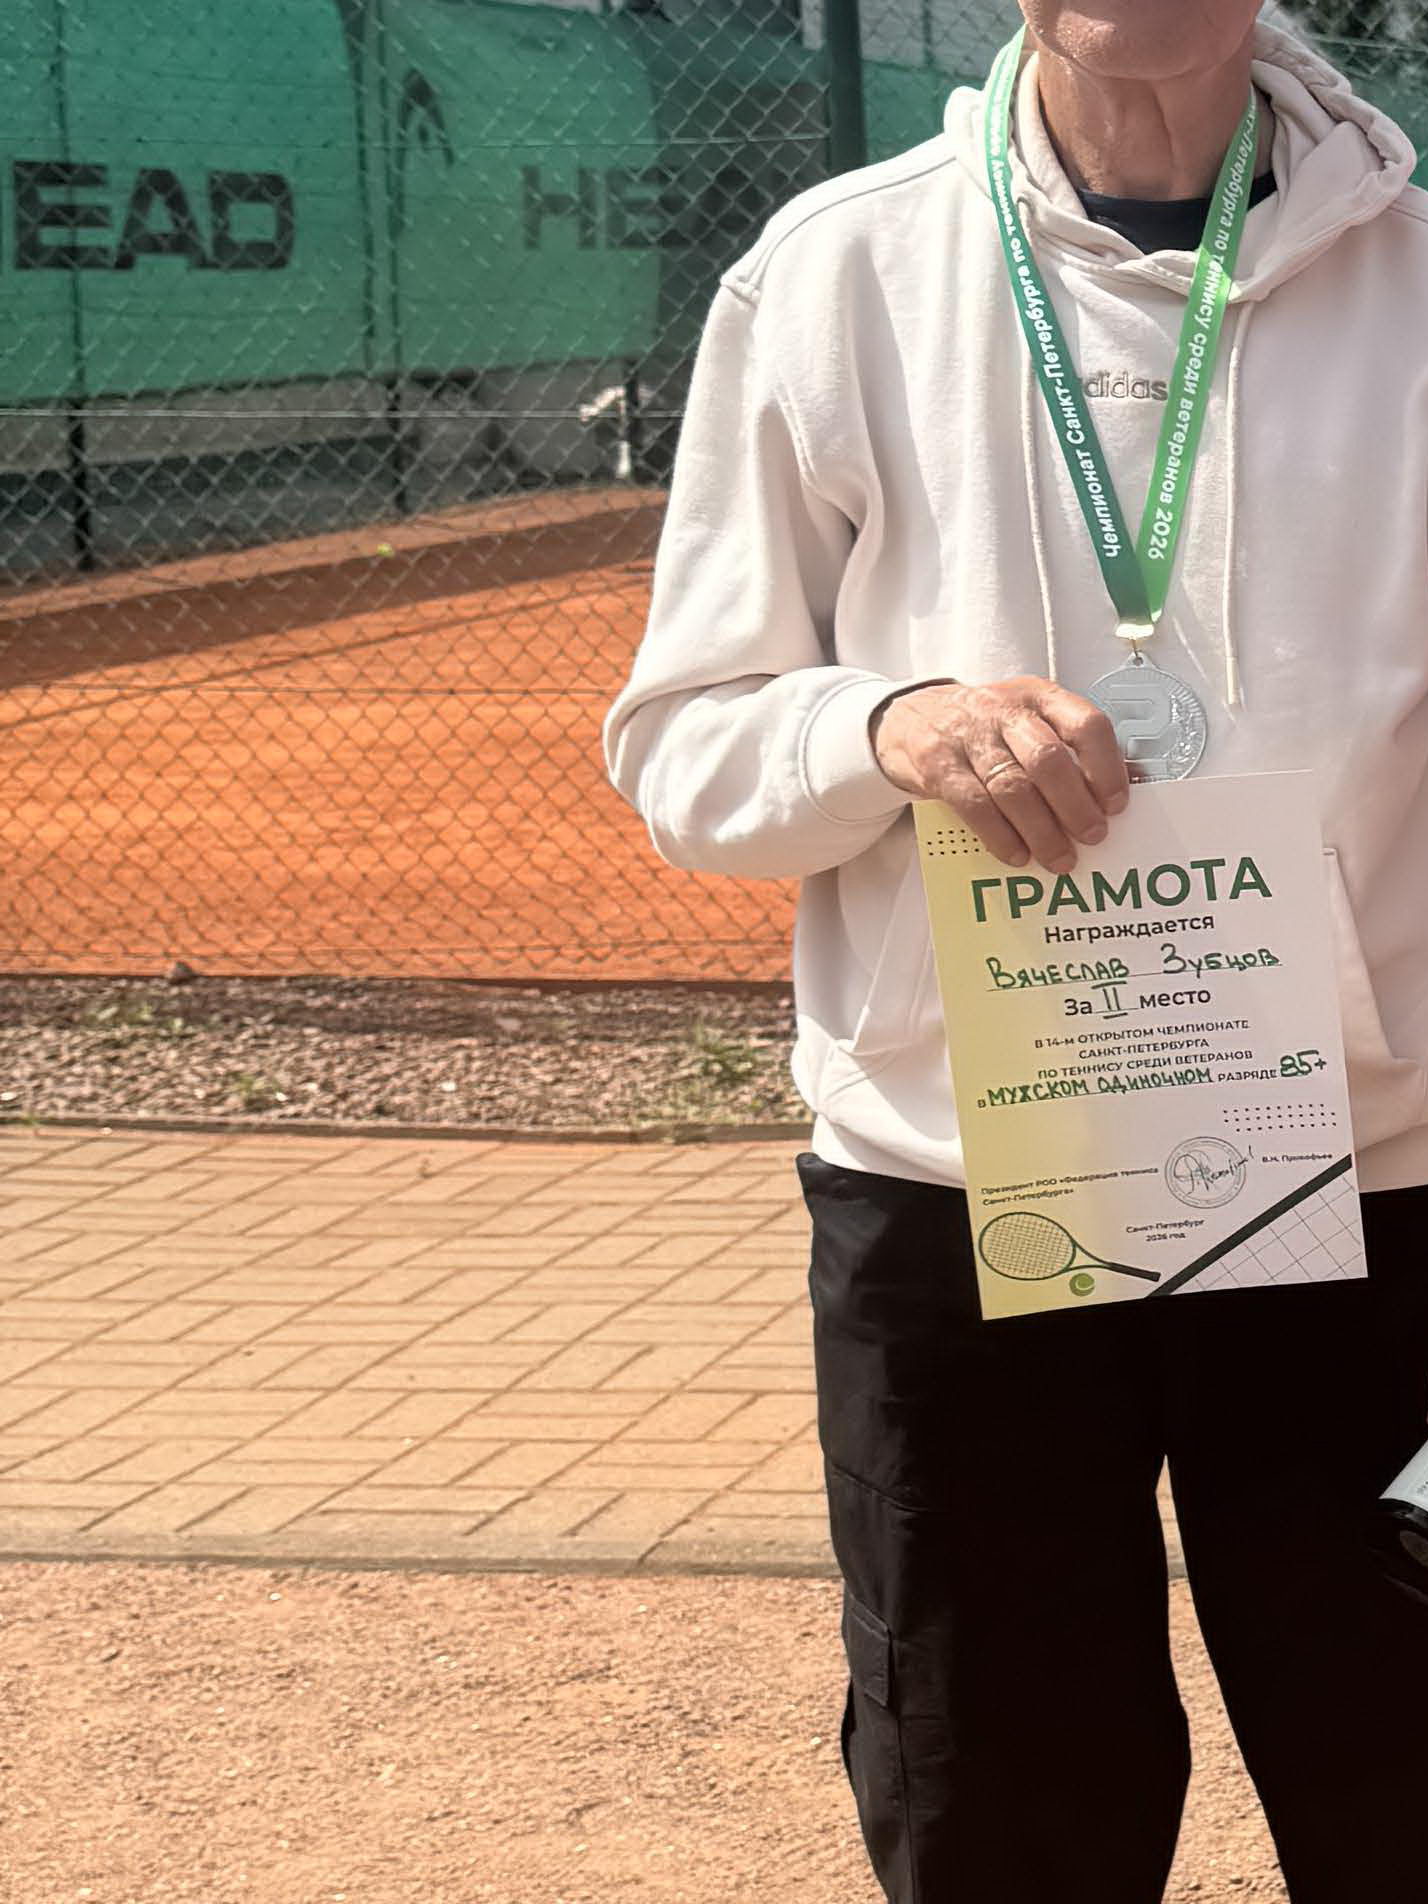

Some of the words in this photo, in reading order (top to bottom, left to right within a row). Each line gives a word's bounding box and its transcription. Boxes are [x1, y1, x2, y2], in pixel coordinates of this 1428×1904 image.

[1010, 238, 1026, 264] по
[1214, 229, 1230, 251] по
[1194, 255, 1225, 330] теннису
[1017, 265, 1085, 445] Санкт-Петербурга
[1184, 333, 1208, 395] среди
[1083, 369, 1168, 402] didas
[1159, 397, 1194, 505] ветеранов
[1076, 448, 1122, 558] Чемпионат
[1147, 508, 1173, 561] 2026
[971, 856, 1273, 923] ГРАМОТА
[1045, 915, 1215, 944] Награждается
[1064, 997, 1092, 1016] За
[1139, 988, 1211, 1010] место
[1077, 1027, 1154, 1044] ОТКРЫТОМ
[1157, 1019, 1250, 1037] ЧЕМПИОНАТЕ
[1078, 1038, 1210, 1060] САНКТ-ПЕТЕРБУРГА
[987, 1079, 1089, 1107] МУЖСКОМ
[1098, 1067, 1213, 1095] ОДИНОЧНОМ
[1217, 1069, 1277, 1083] РАЗРЯДЕ
[1280, 1049, 1329, 1078] 85+
[1038, 1068, 1058, 1080] ПО
[1061, 1061, 1123, 1078] ТЕННИСУ
[1127, 1056, 1172, 1071] СРЕДИ
[1175, 1050, 1253, 1068] ВЕТЕРАНОВ
